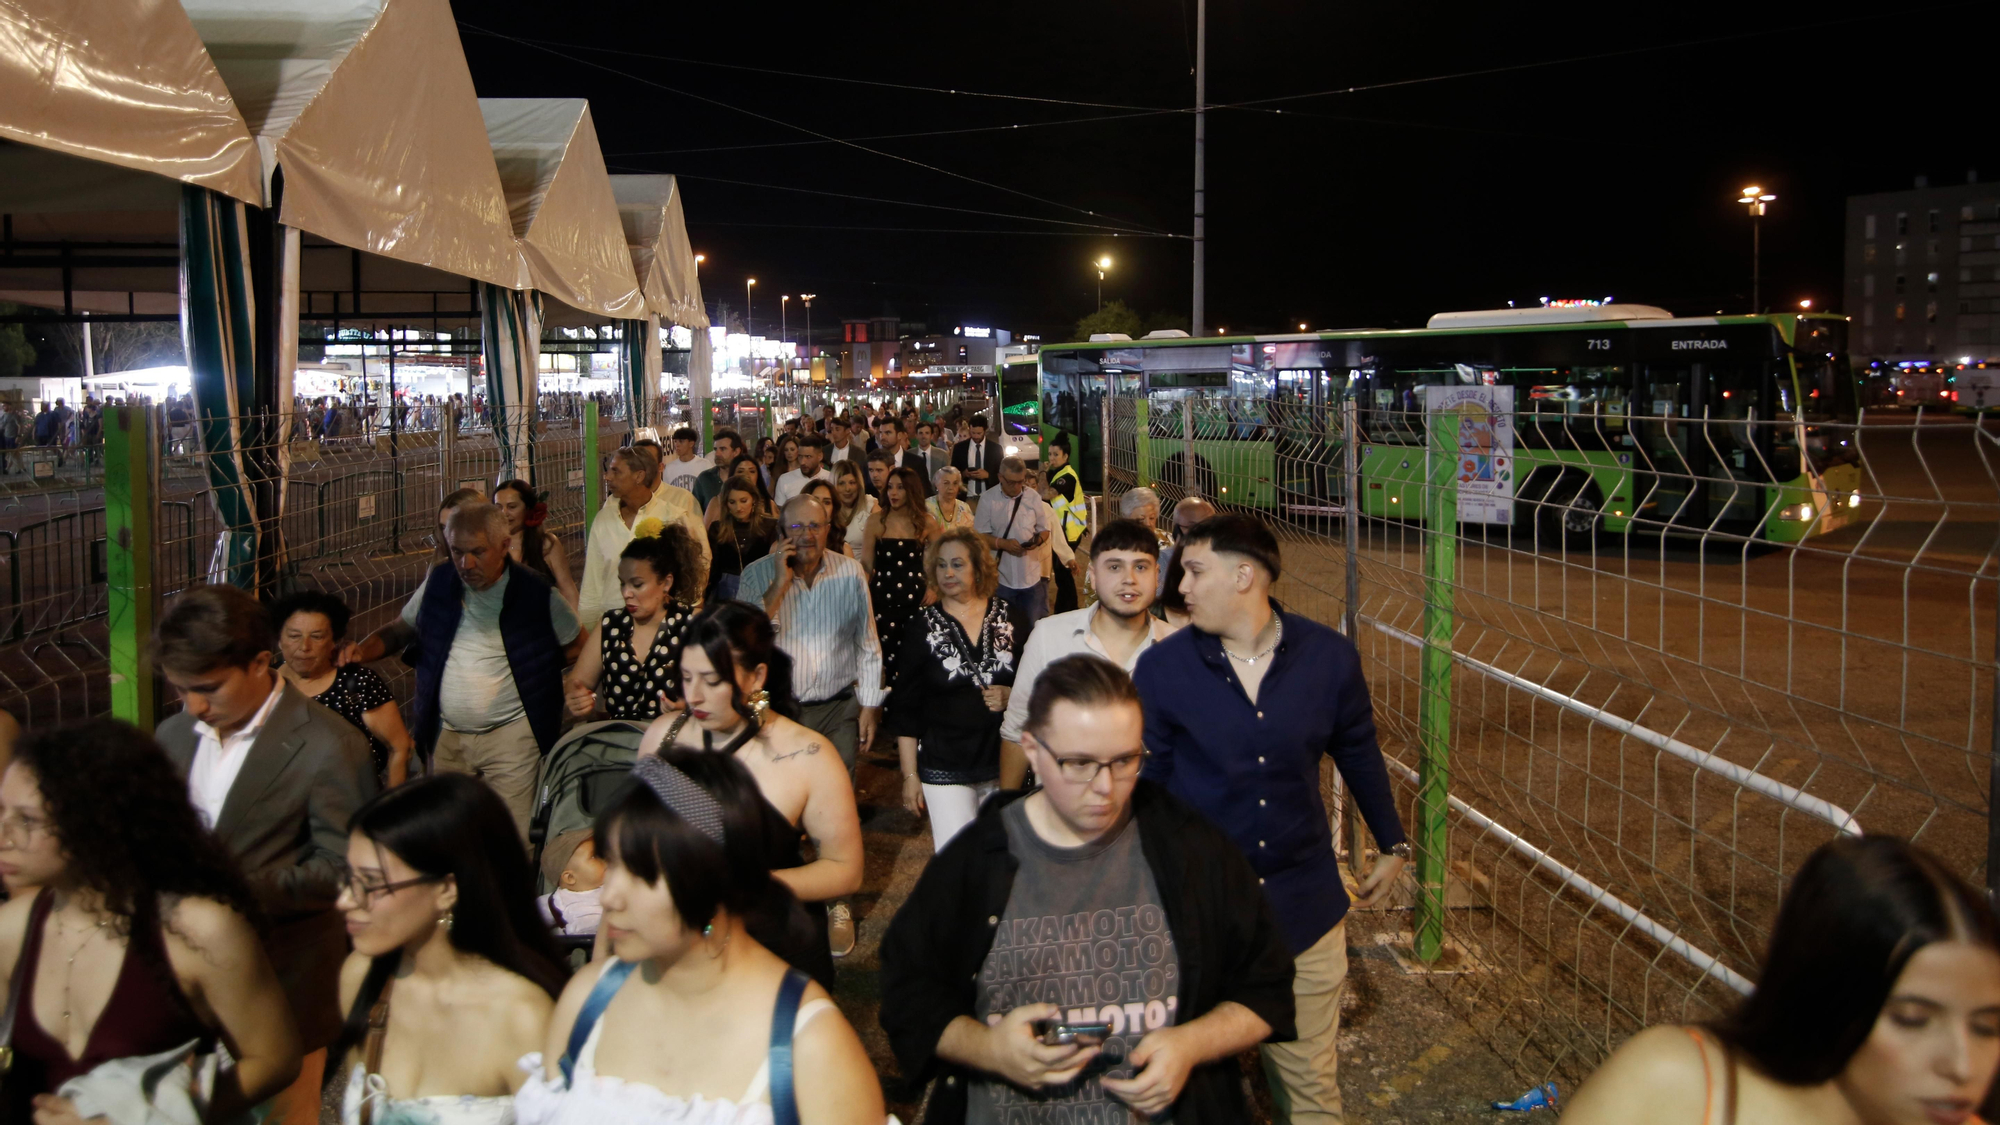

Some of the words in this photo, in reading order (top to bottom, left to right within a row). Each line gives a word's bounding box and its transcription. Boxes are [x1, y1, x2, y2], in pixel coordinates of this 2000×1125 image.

[1587, 339, 1611, 350] 713
[1671, 339, 1727, 350] ENTRADA
[1306, 350, 1332, 359] ALIDA
[1099, 357, 1121, 365] SALIDA
[1456, 390, 1478, 400] DESDE
[1479, 393, 1487, 403] EL
